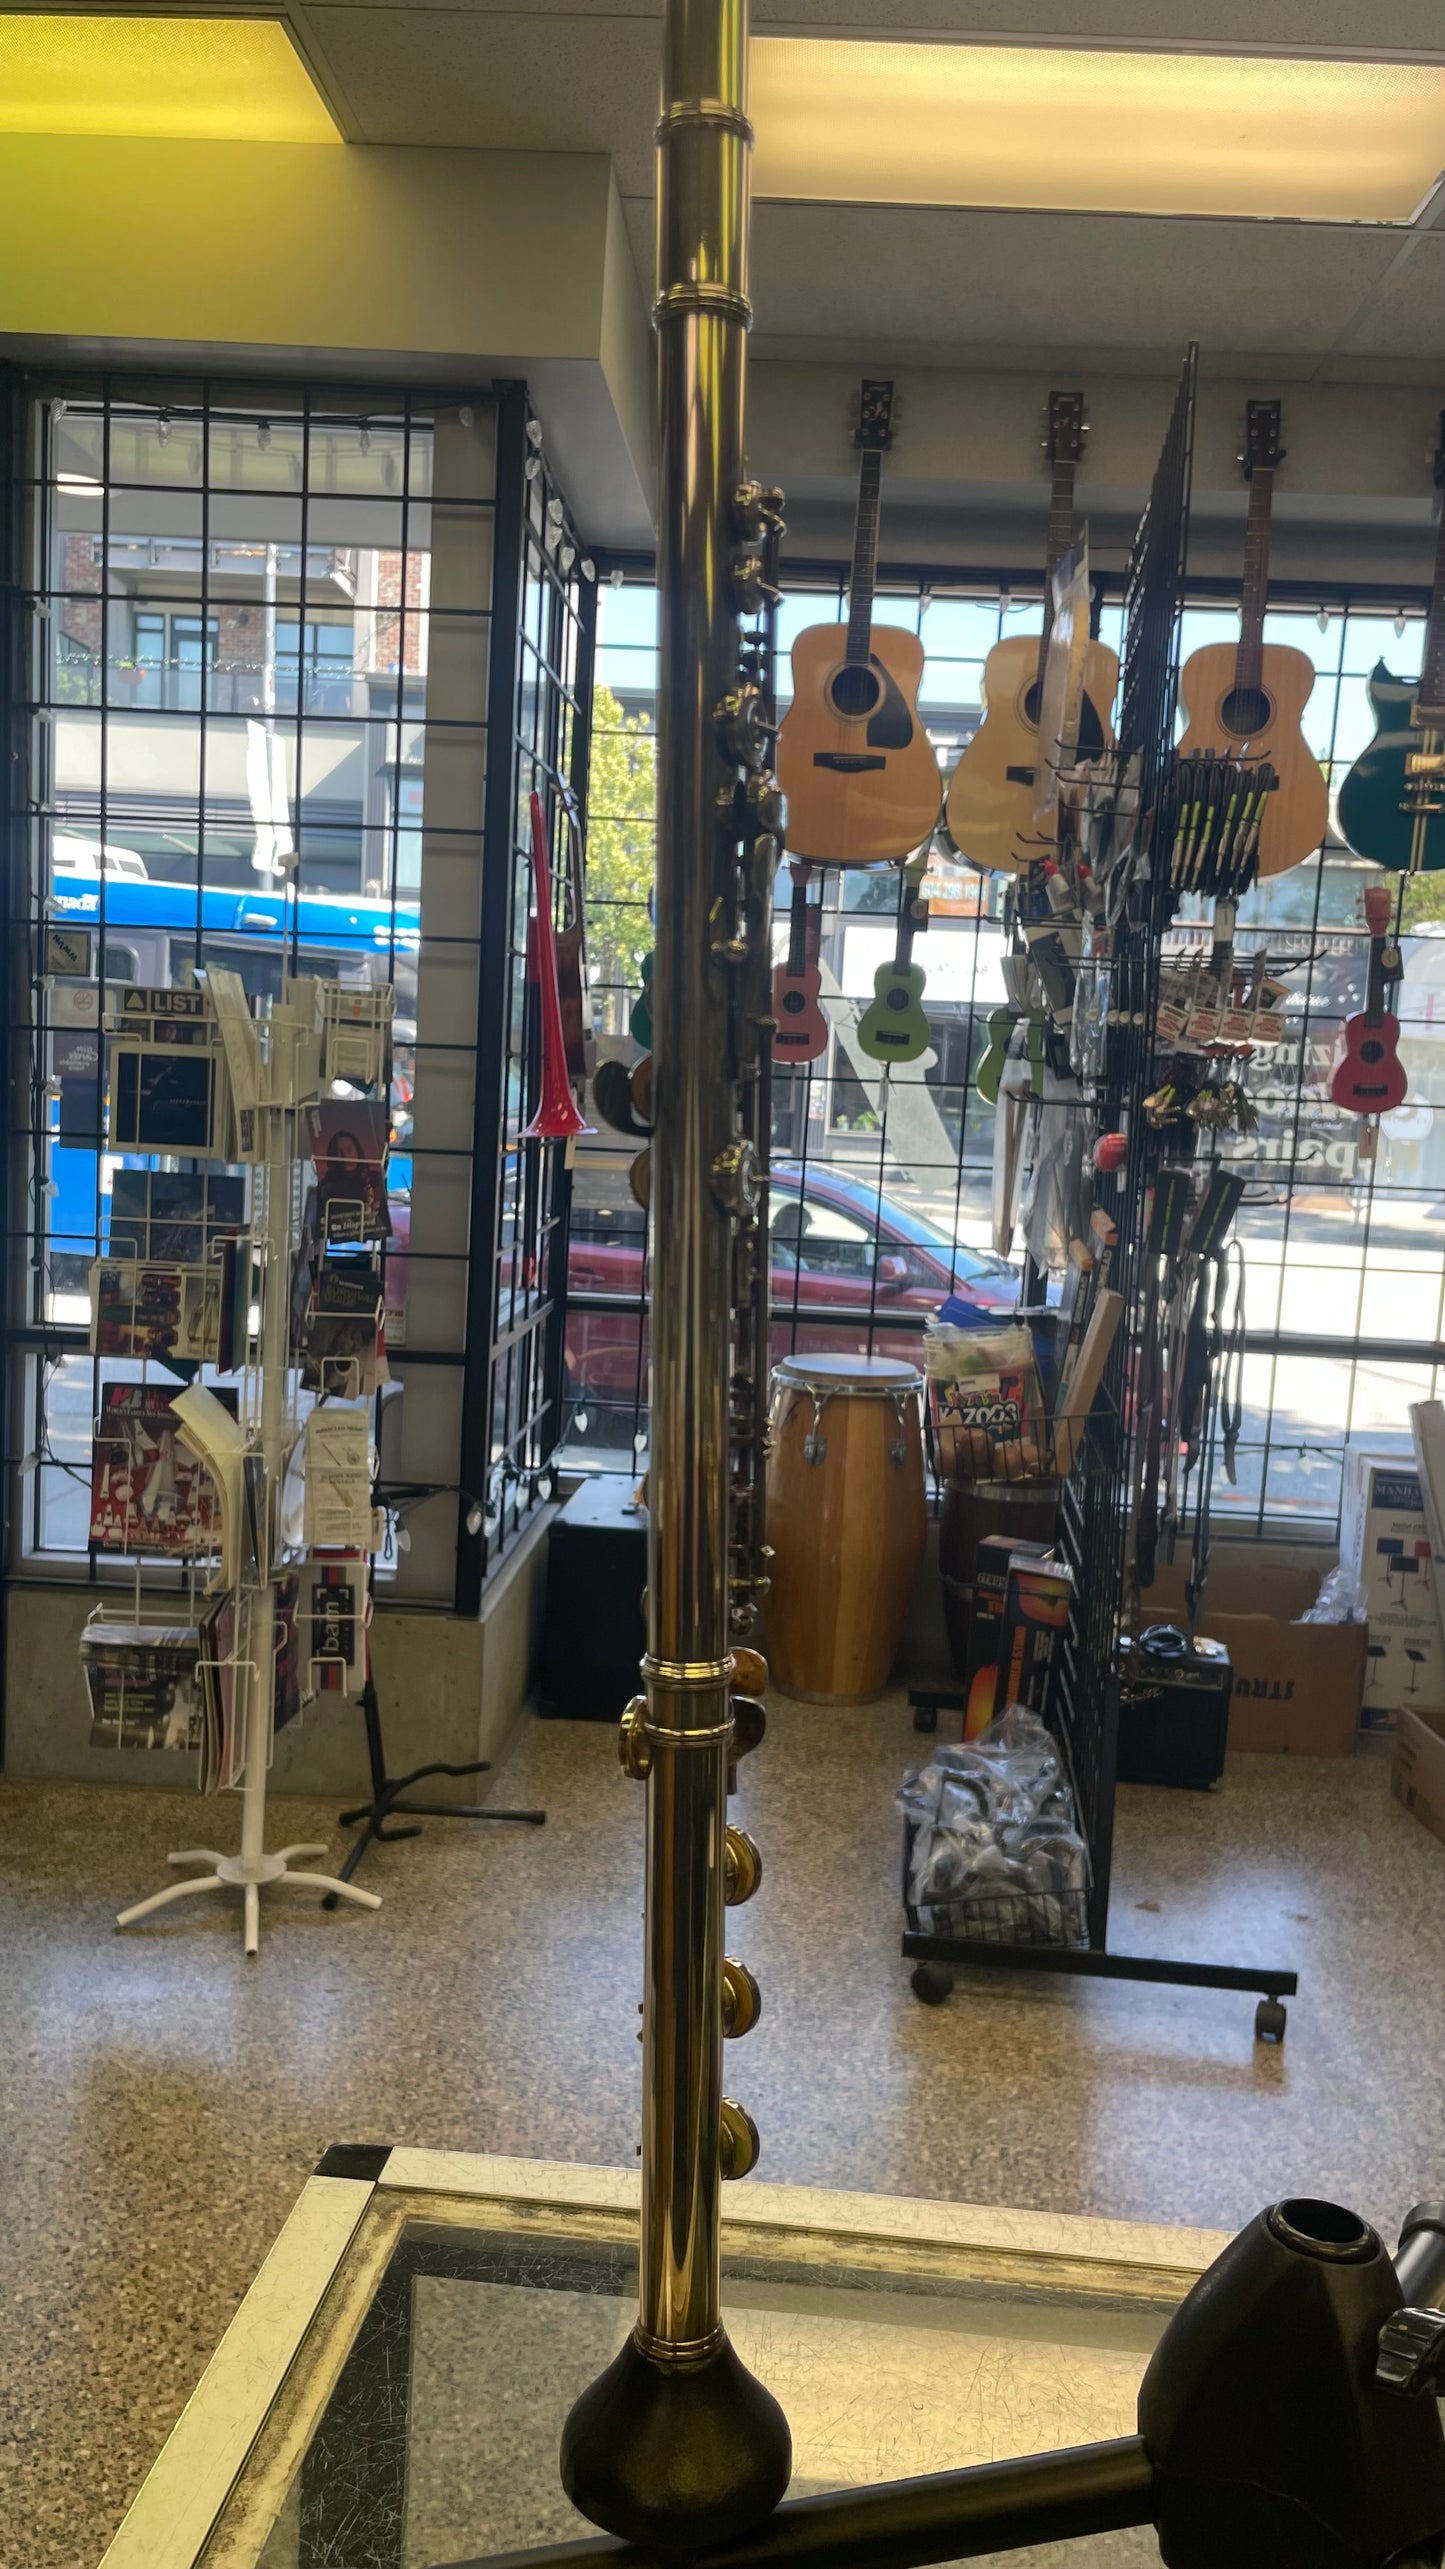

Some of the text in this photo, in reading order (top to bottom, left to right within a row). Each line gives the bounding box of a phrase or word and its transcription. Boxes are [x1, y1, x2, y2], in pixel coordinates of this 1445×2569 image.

[56, 894, 98, 911] nada
[53, 935, 77, 962] NAMM
[155, 993, 200, 1012] LIST
[1375, 1483, 1420, 1497] MANHA
[321, 1601, 340, 1651] bam
[1234, 1678, 1297, 1700] STRU
